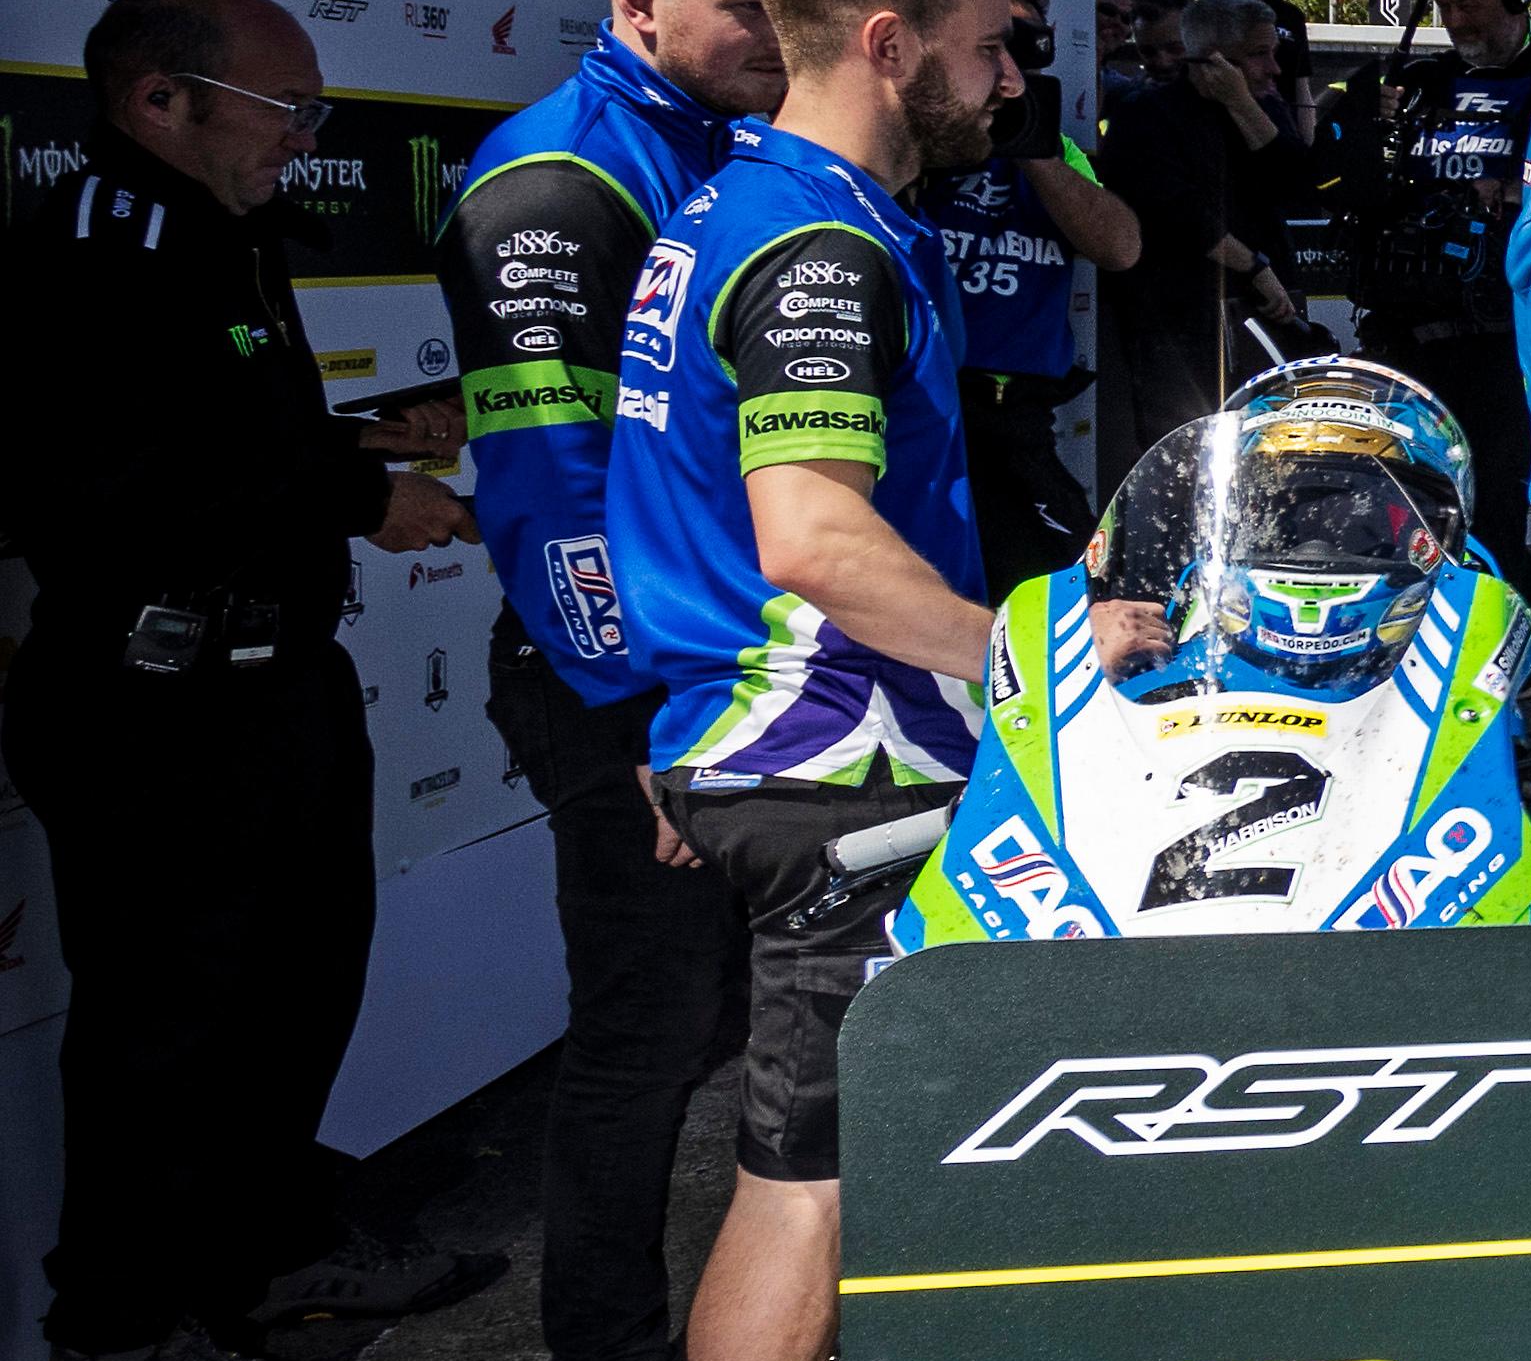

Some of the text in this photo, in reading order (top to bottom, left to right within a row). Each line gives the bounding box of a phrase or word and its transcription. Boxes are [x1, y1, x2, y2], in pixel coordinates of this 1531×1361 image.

[1429, 153, 1485, 181] 109
[978, 229, 1066, 267] MEDIA
[501, 261, 578, 289] COMPLETE
[779, 290, 862, 319] COMPLETE
[784, 326, 872, 346] DIAMOND
[327, 356, 375, 374] DUNLOP
[797, 366, 840, 378] HEL
[473, 385, 603, 416] Kawasaki
[1281, 630, 1368, 652] TORPEDO.COM
[1189, 712, 1324, 729] DUNLOP
[1136, 749, 1330, 913] 2
[1206, 801, 1318, 856] HARRISON
